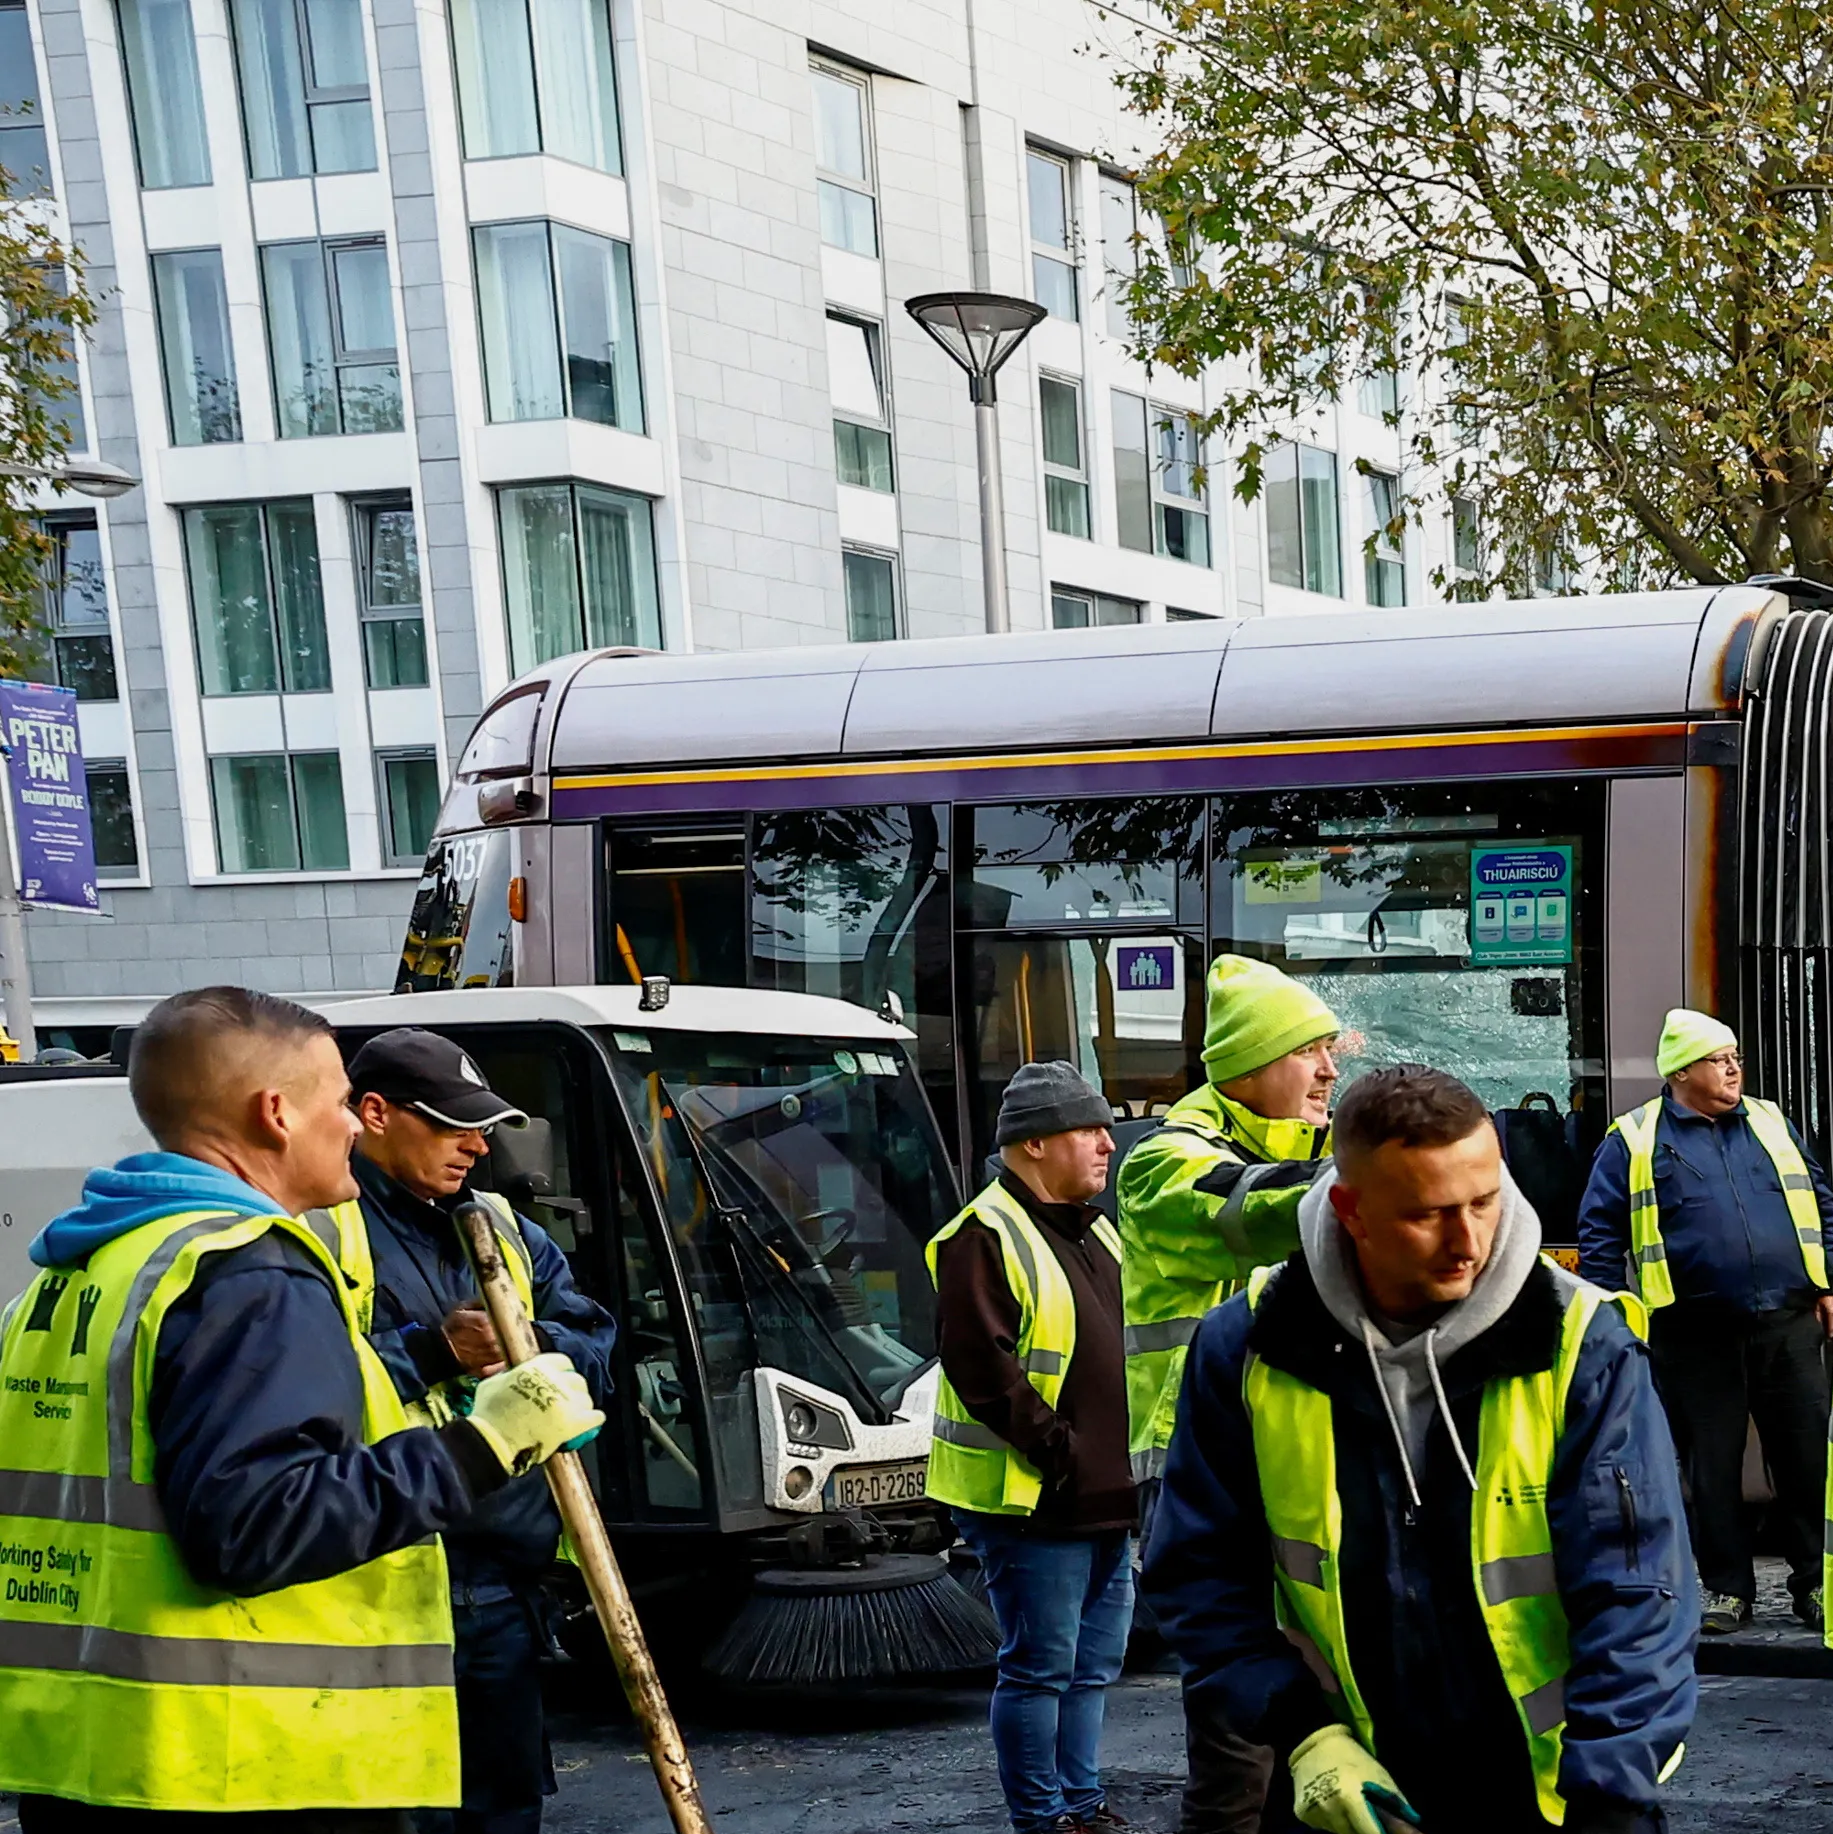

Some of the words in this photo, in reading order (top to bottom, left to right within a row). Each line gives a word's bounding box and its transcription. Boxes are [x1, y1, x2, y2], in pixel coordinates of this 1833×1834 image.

[9, 718, 77, 754] PETER
[27, 749, 69, 782] PAN
[442, 837, 489, 884] 5037
[0, 1542, 43, 1573] orking
[6, 1578, 57, 1604] Dublin
